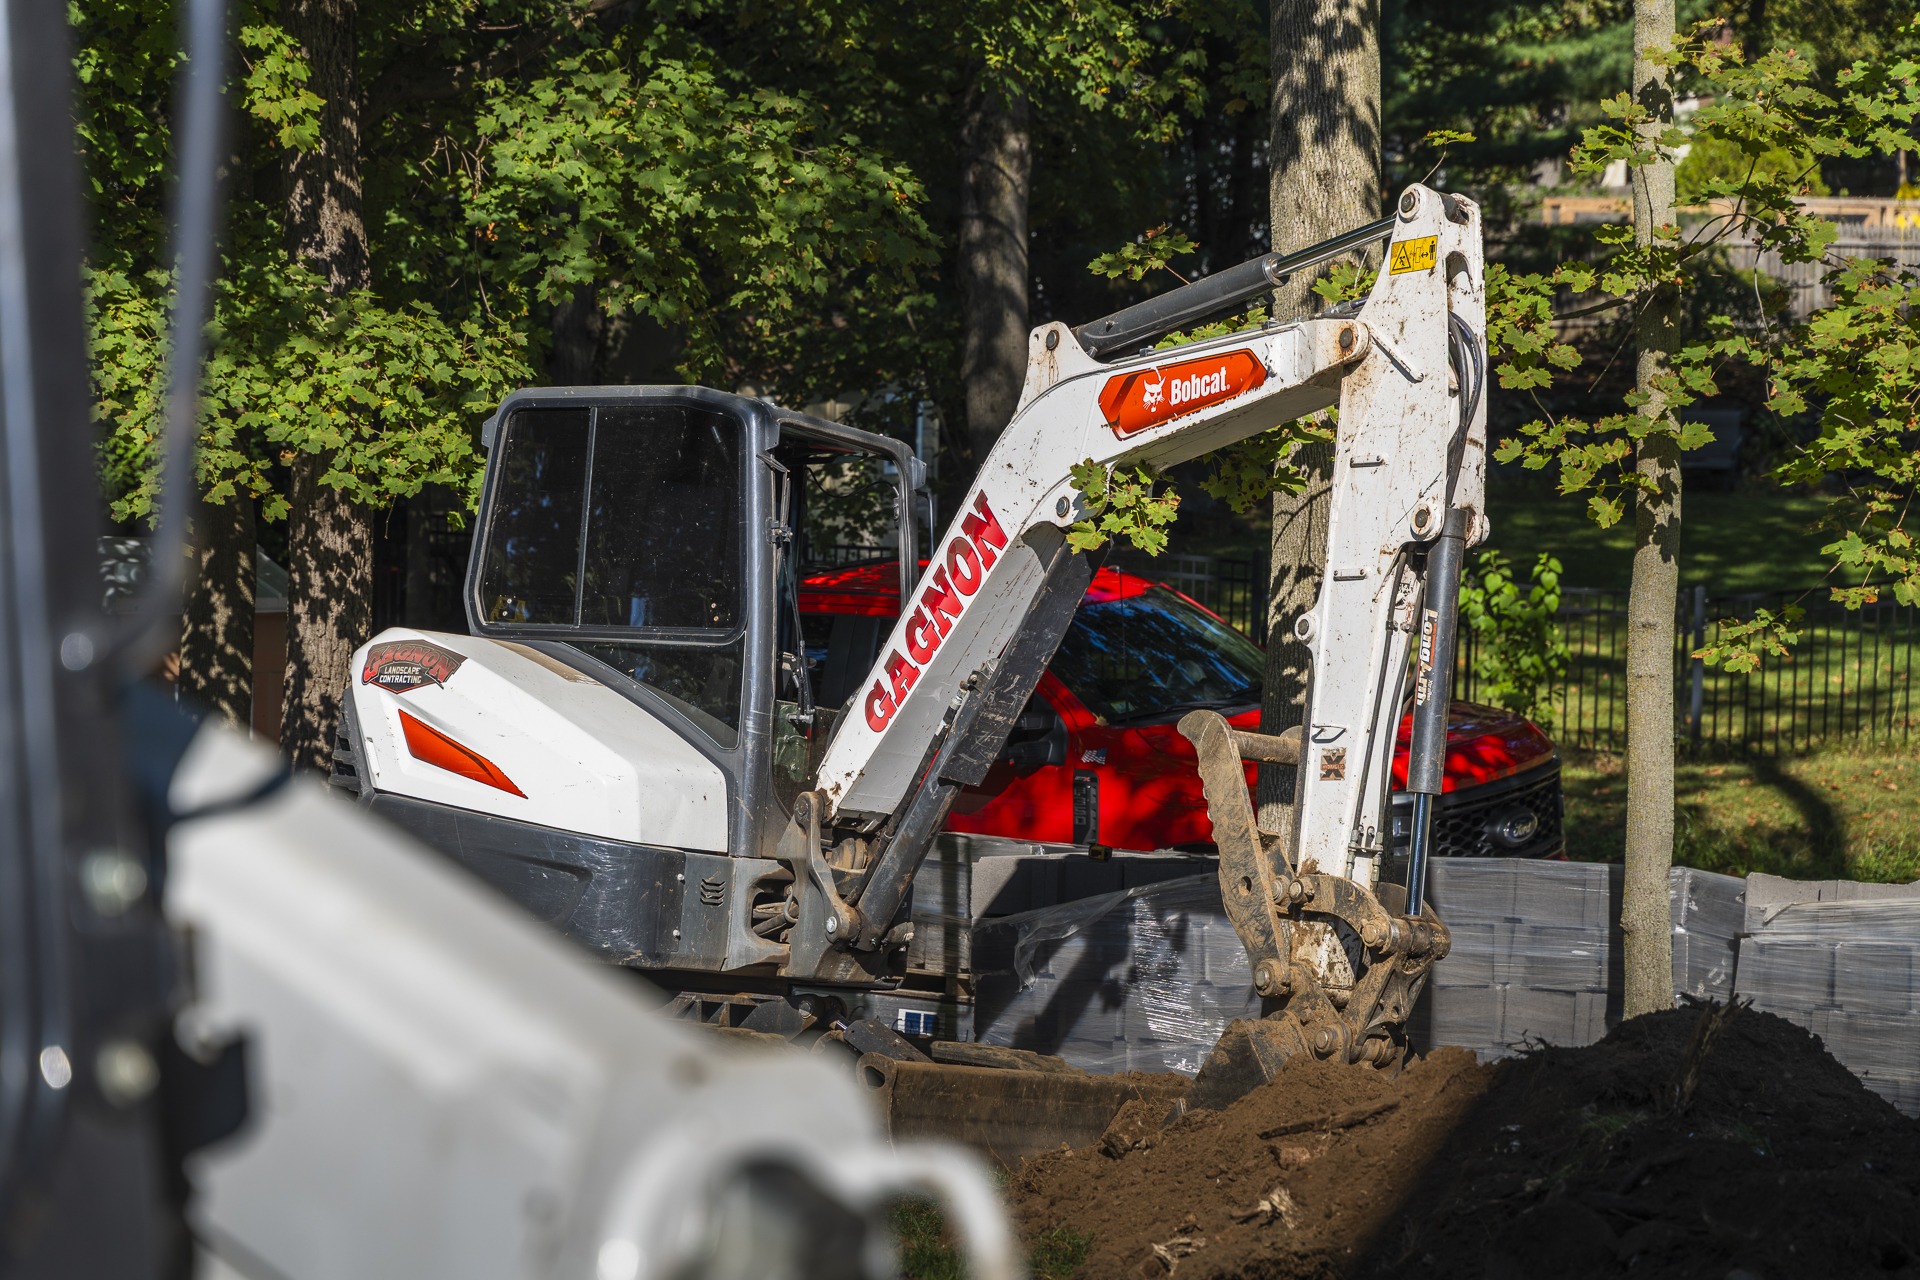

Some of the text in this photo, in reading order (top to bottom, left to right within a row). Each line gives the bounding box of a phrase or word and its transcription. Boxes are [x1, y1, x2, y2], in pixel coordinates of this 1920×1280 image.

[1170, 366, 1227, 406] Bobcat
[865, 489, 1008, 733] GAGNON
[362, 644, 459, 683] GAGNON
[379, 675, 422, 684] CONTRACTING
[384, 666, 421, 675] LANDSCAPE
